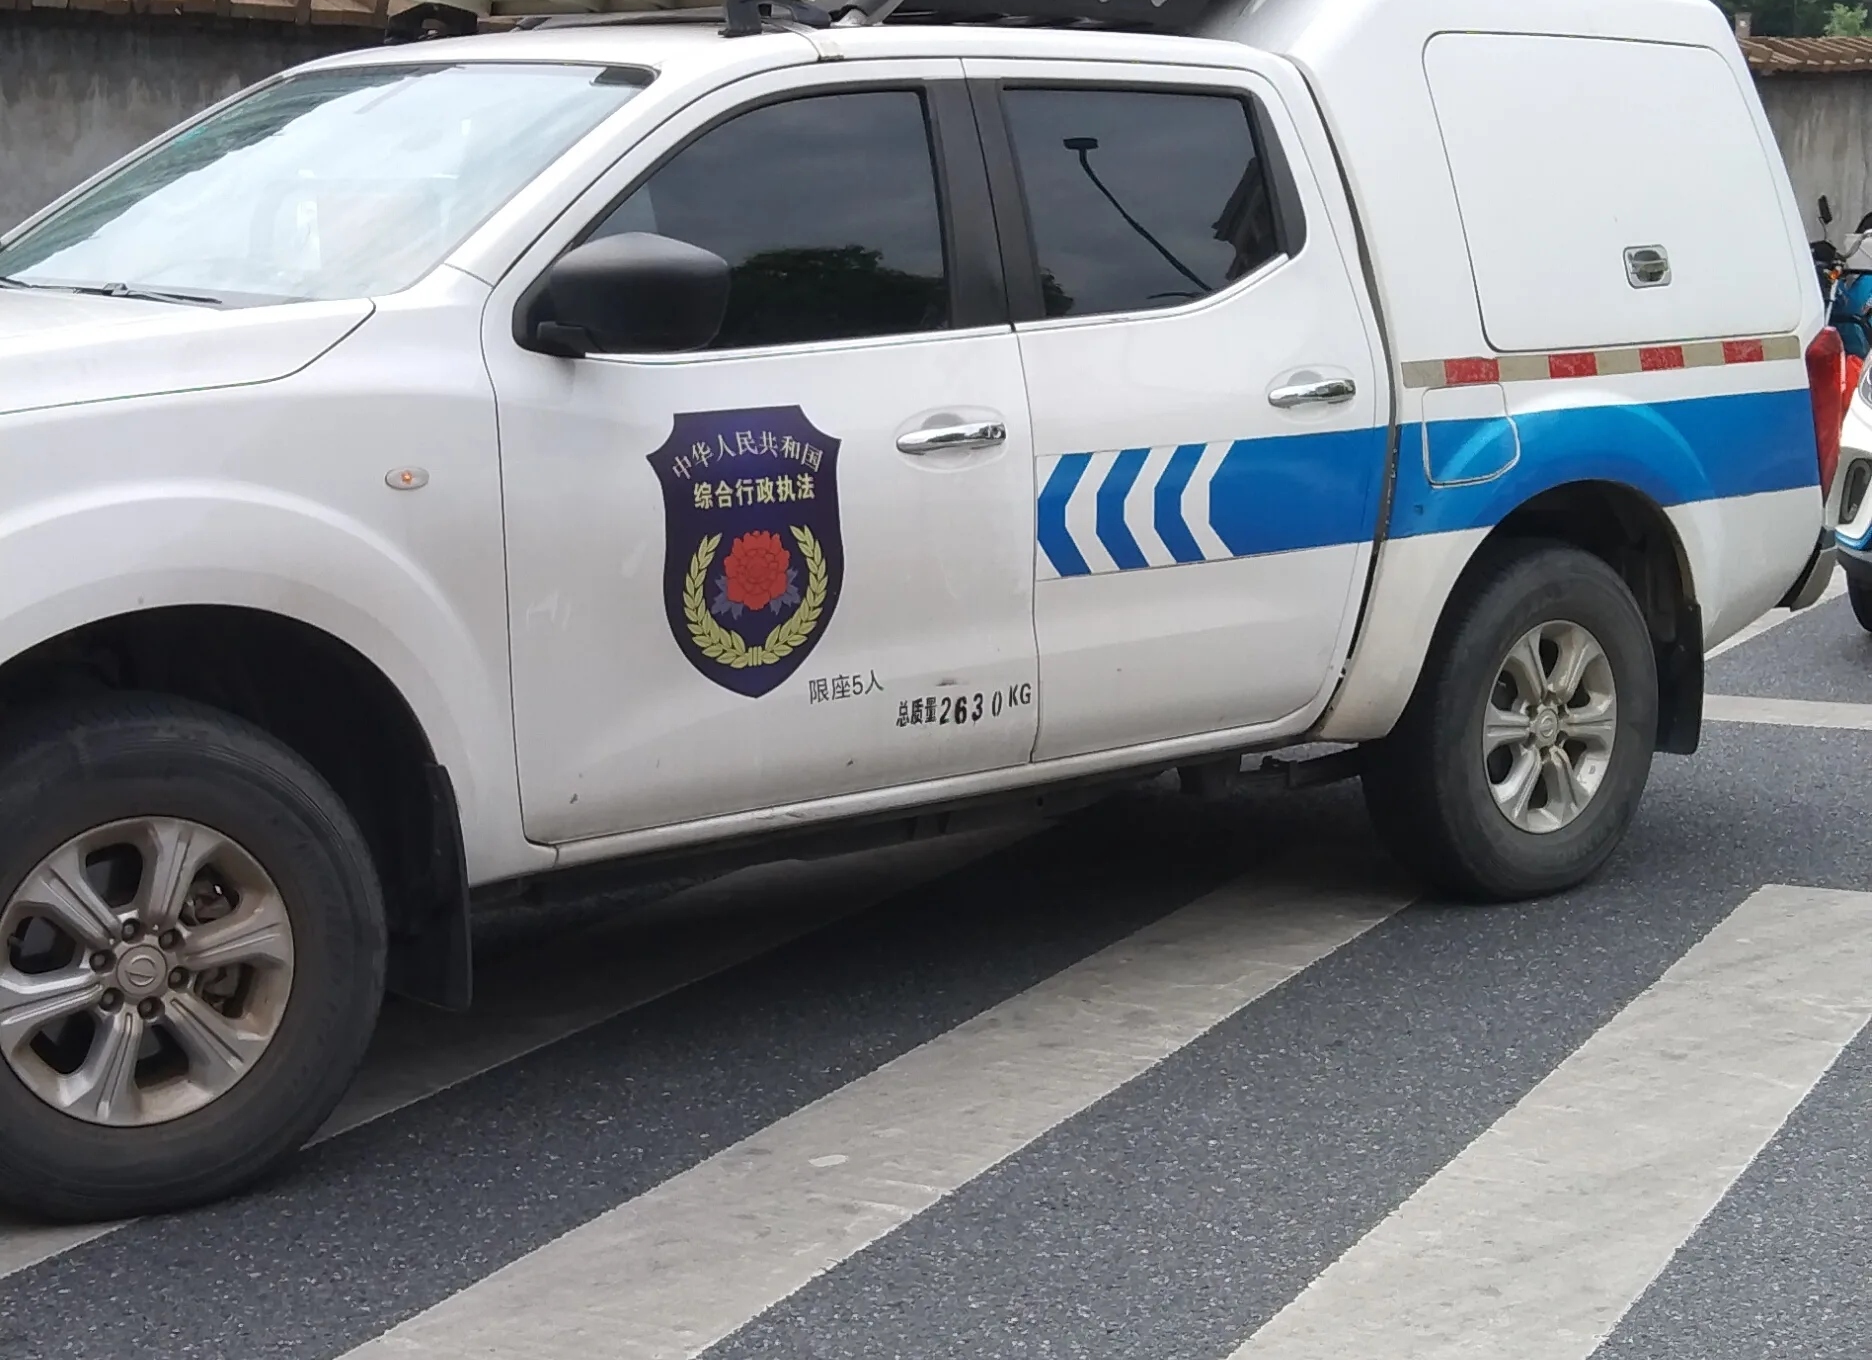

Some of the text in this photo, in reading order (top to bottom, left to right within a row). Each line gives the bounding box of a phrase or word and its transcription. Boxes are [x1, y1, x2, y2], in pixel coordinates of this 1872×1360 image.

[672, 430, 823, 480] 中华人民共和国
[693, 473, 816, 510] 综合行政执法
[808, 669, 884, 704] 限座5人
